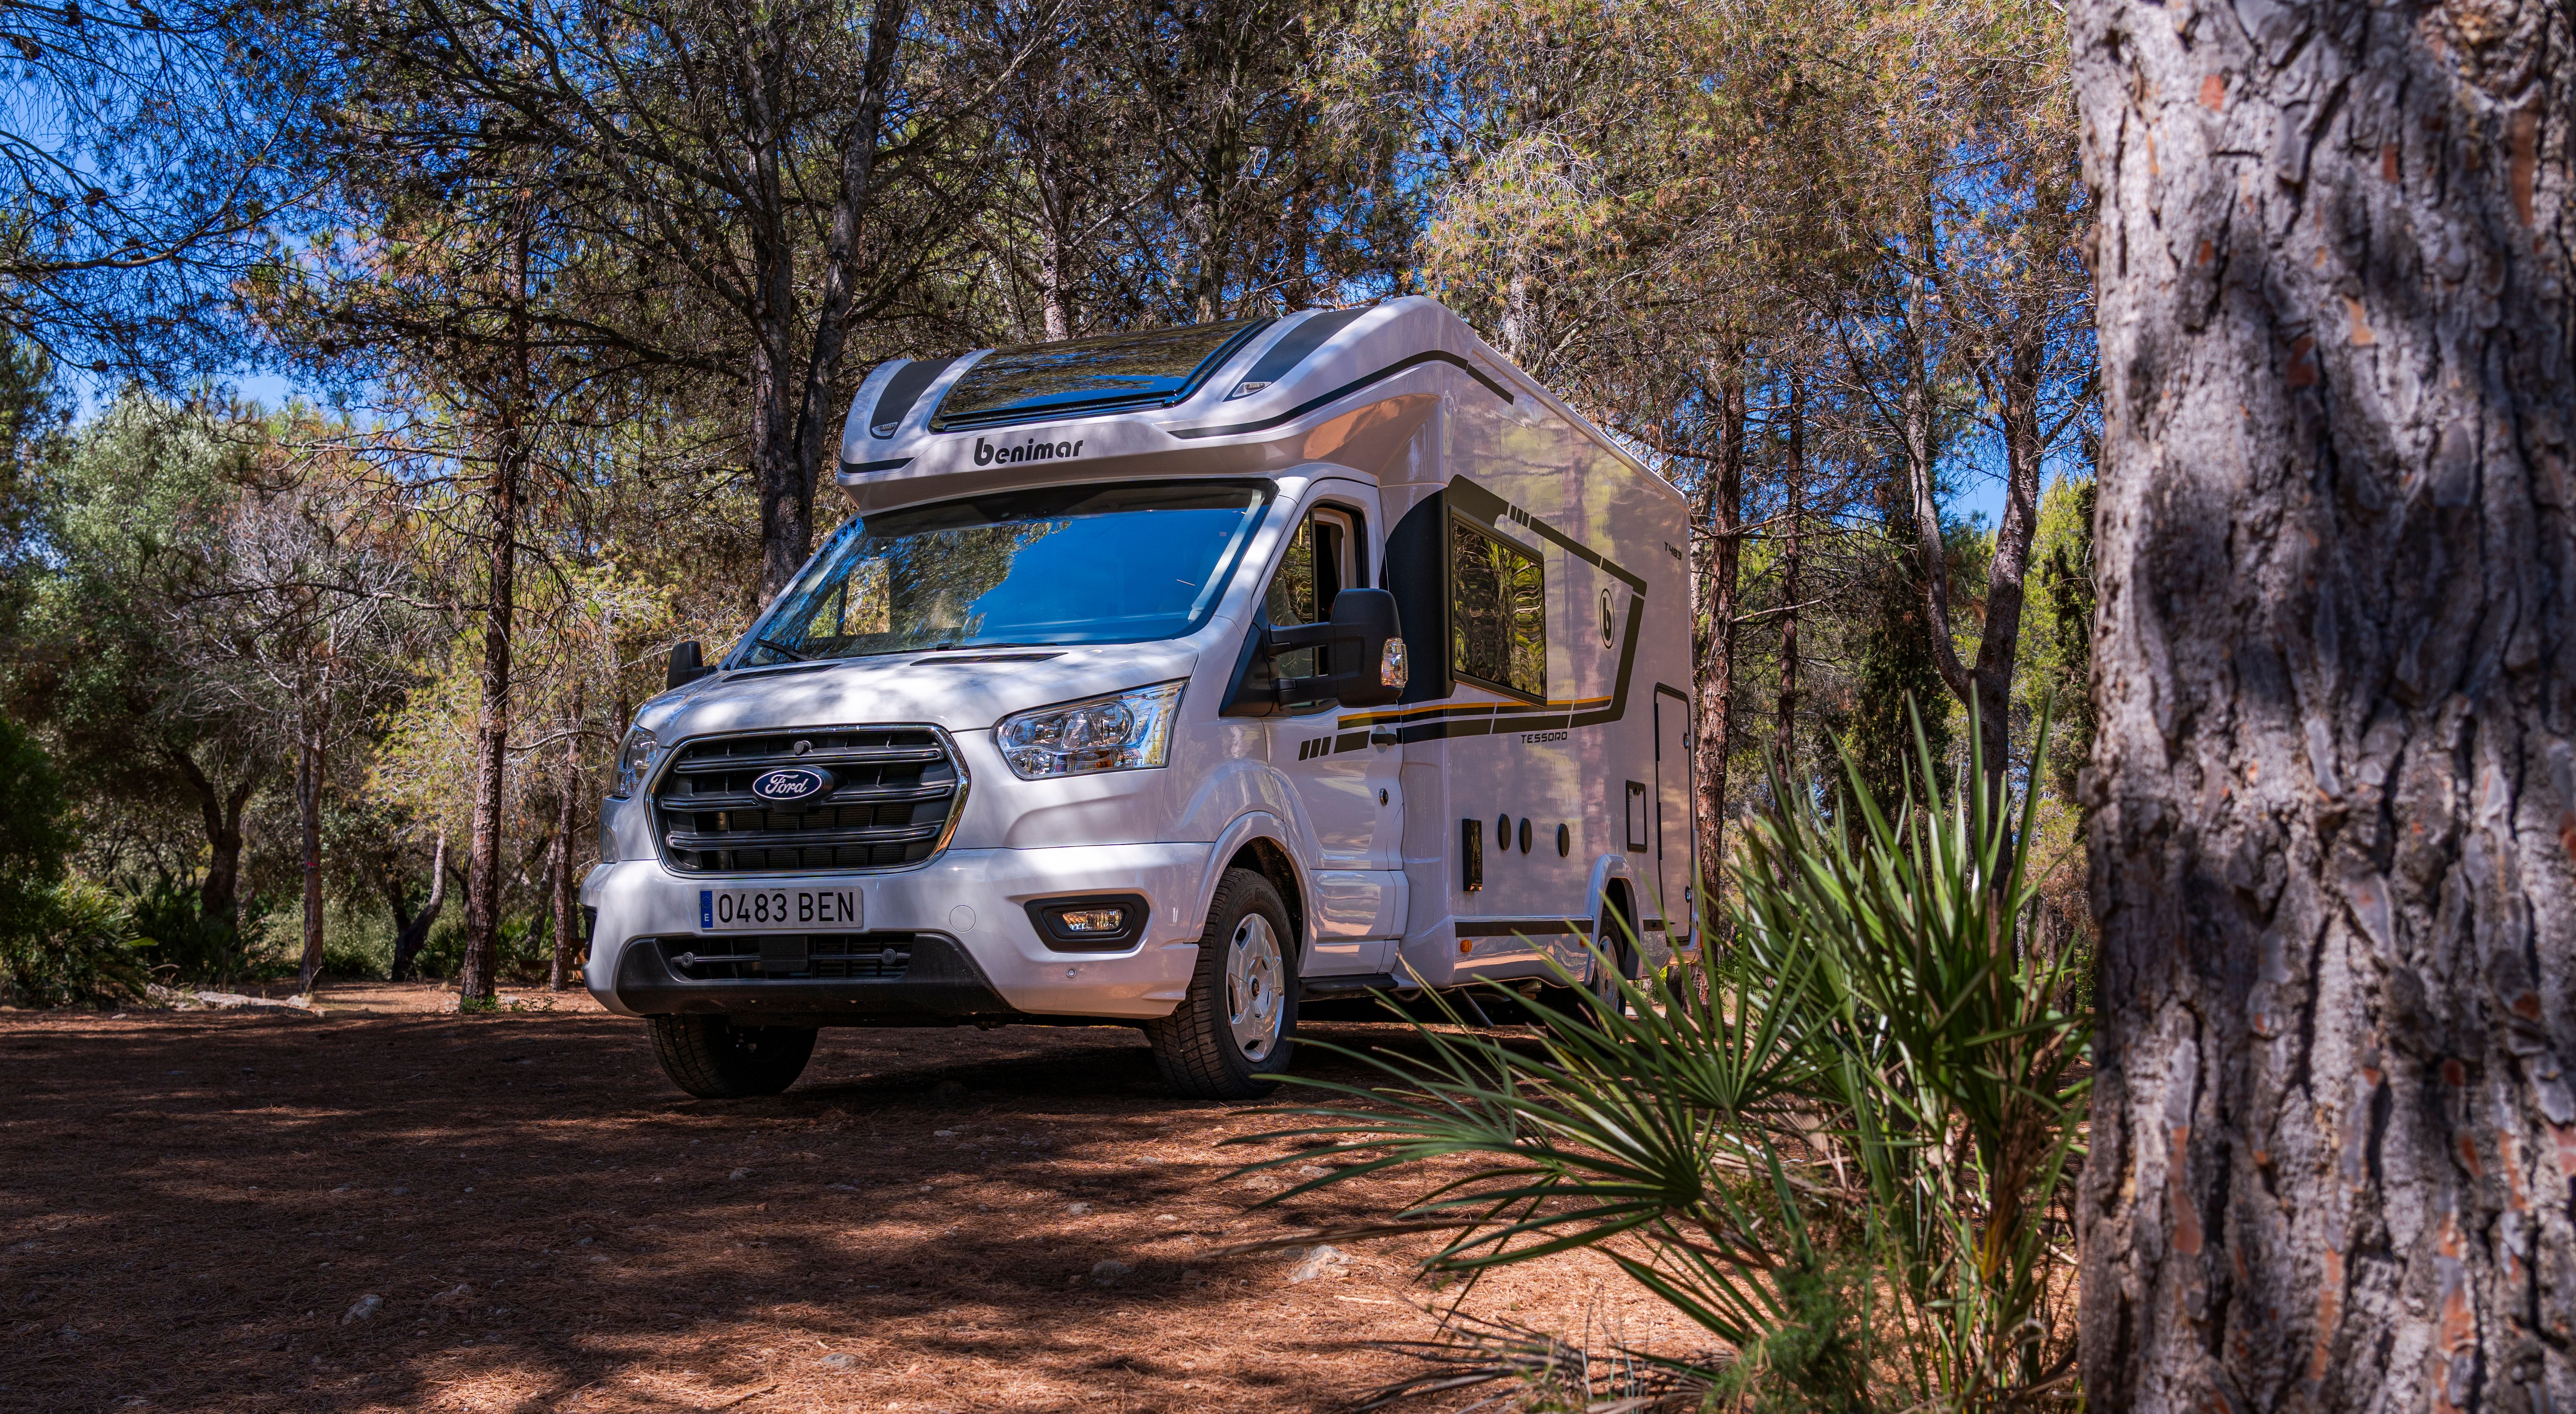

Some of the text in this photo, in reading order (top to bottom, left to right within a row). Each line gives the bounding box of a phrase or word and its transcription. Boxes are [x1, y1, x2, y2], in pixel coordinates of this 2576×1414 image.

[973, 437, 1084, 466] benimar
[1664, 541, 1682, 561] T483
[1603, 597, 1612, 641] b
[1520, 731, 1568, 744] TESSORO
[765, 774, 809, 794] Ford
[704, 913, 709, 921] E
[719, 892, 854, 923] 0483 BEN
